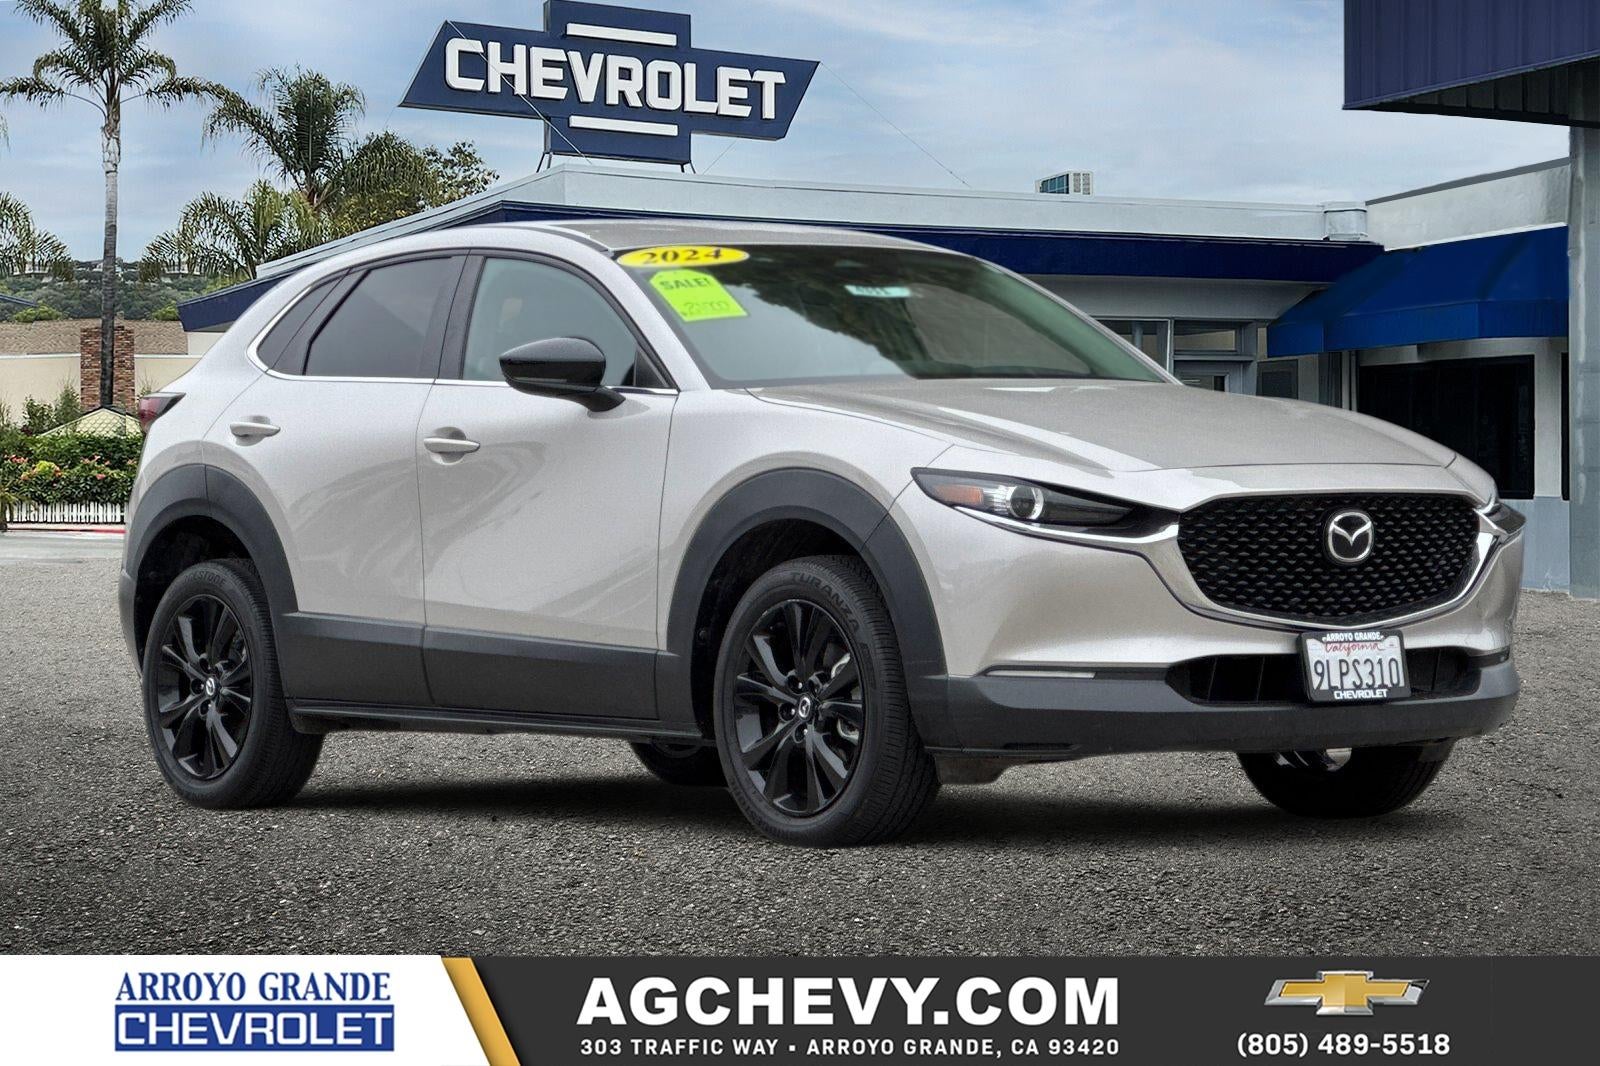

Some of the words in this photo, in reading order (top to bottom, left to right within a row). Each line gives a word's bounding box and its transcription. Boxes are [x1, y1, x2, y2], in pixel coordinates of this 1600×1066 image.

[445, 37, 786, 120] CHEVROLET
[640, 248, 722, 264] 2024
[660, 277, 711, 290] SALE!
[791, 572, 859, 632] TURANZA
[1326, 632, 1354, 641] ARROYO
[1354, 631, 1381, 640] GRANDE
[1325, 642, 1385, 656] California
[1313, 657, 1401, 690] 9LPS310
[1334, 689, 1388, 700] CHEVROLET
